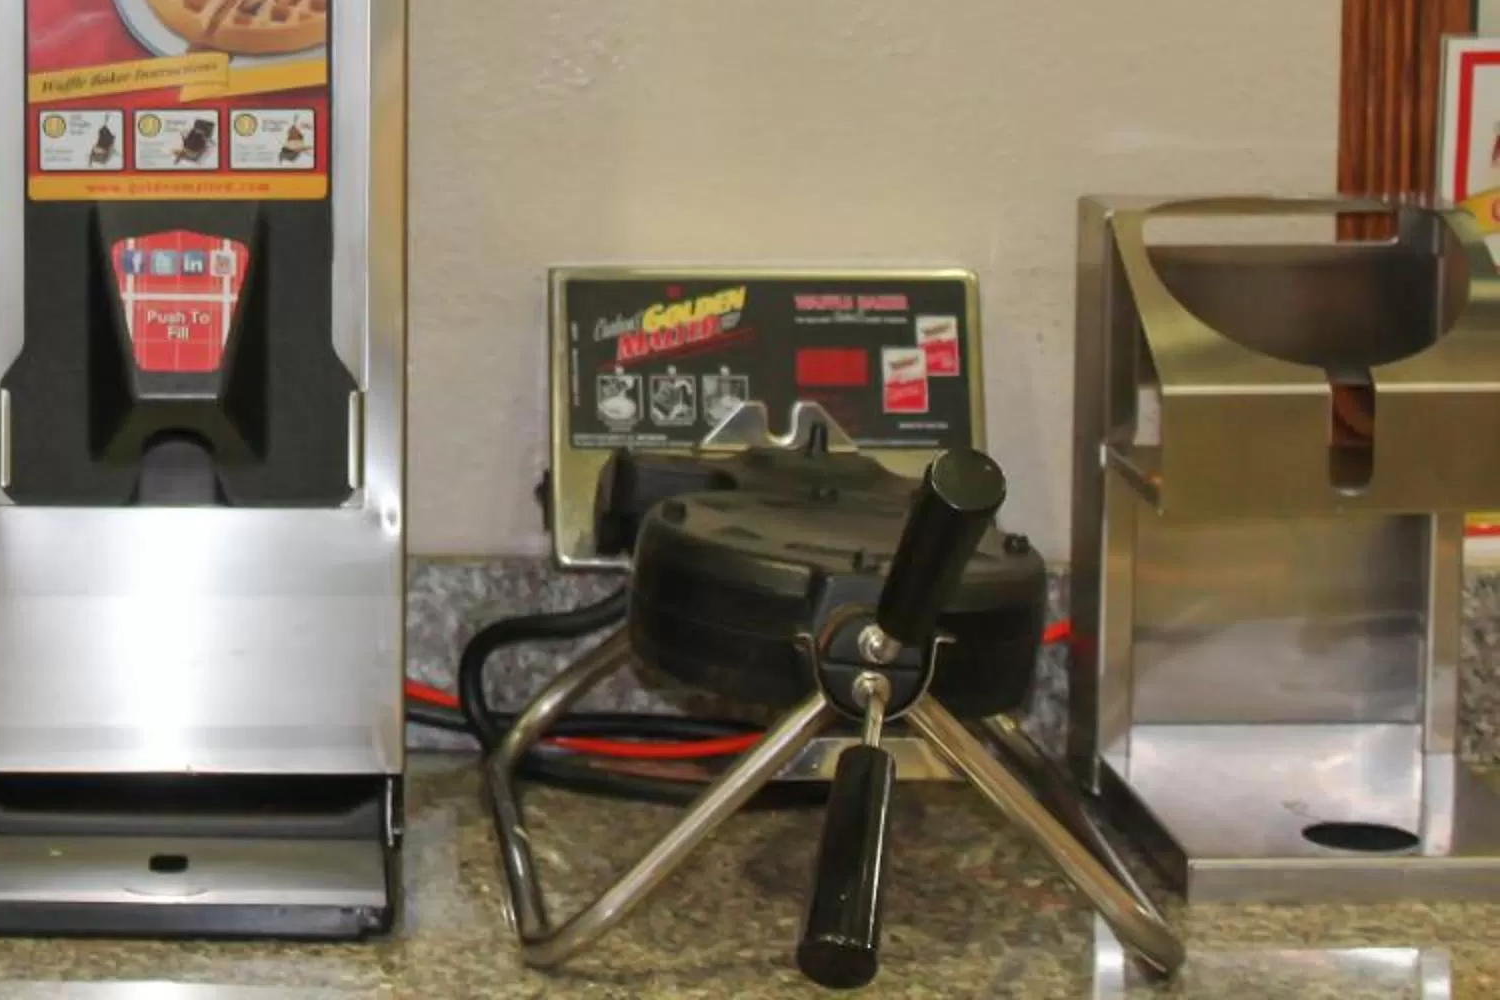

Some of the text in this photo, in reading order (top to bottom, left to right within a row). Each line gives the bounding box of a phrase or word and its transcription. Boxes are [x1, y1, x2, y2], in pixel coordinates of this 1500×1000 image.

[642, 285, 747, 333] GOLDEN
[147, 311, 211, 325] Push To
[167, 326, 190, 341] Fill
